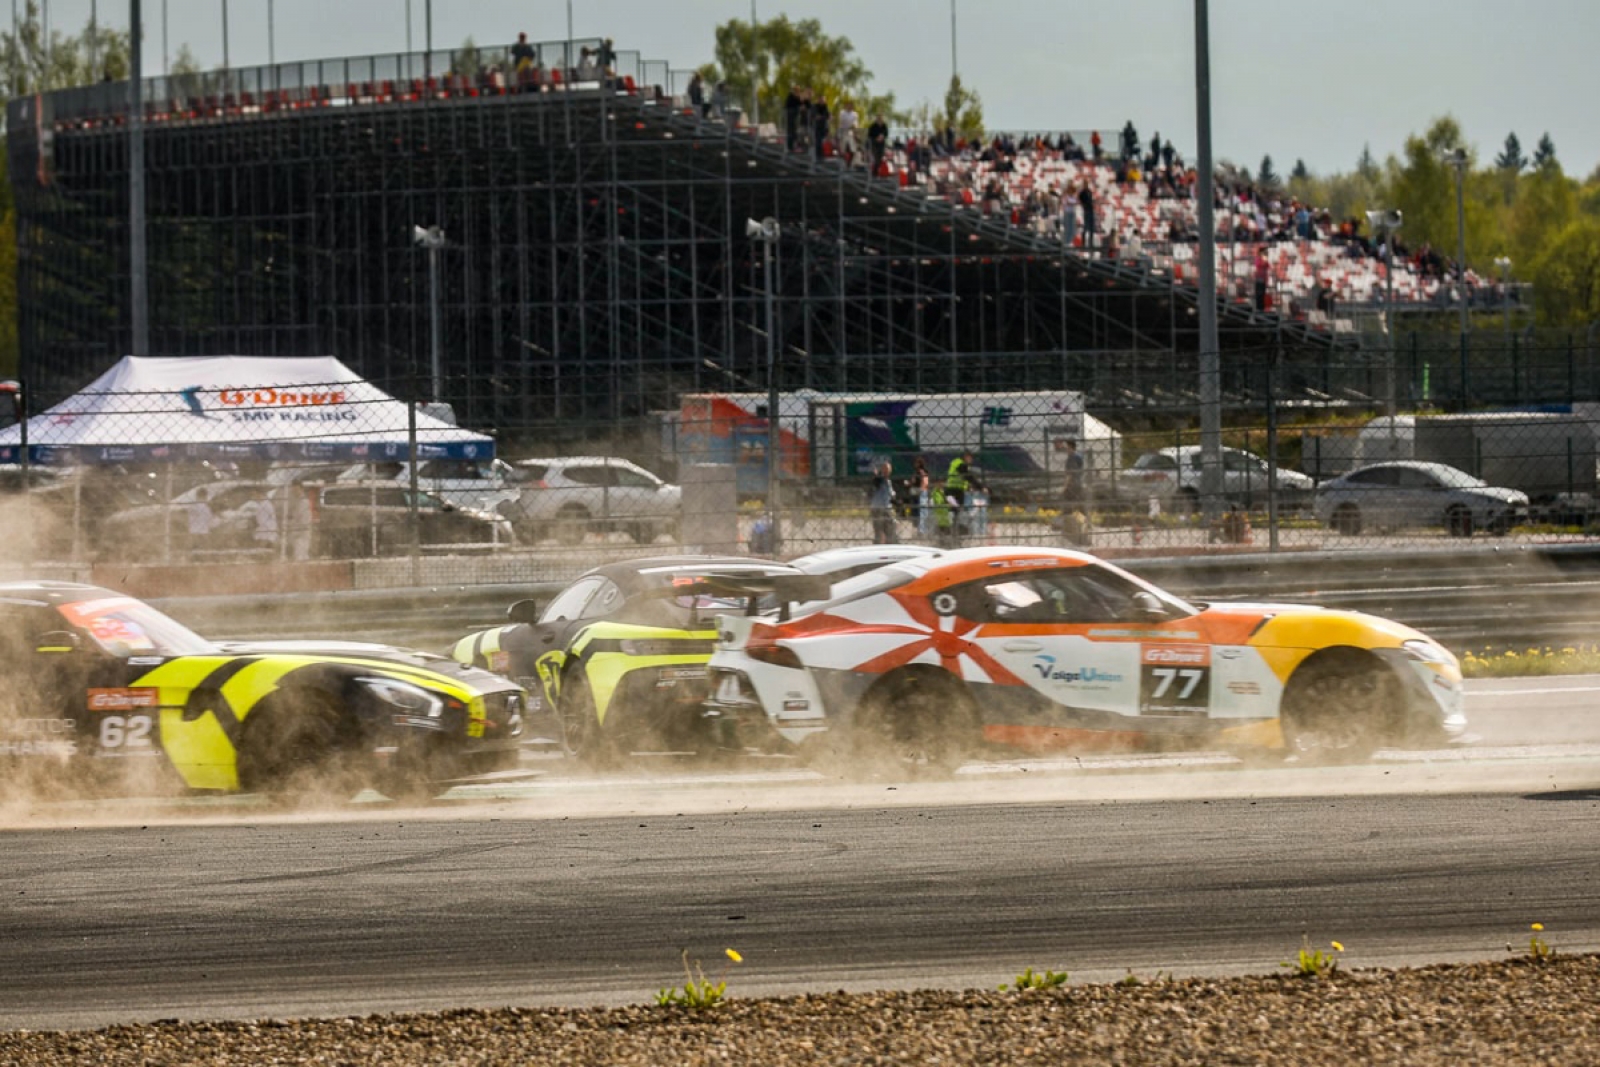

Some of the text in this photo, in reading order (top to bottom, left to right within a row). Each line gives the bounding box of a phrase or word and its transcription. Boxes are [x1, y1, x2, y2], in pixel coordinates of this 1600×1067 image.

[232, 410, 357, 422] SMP RACING
[1151, 668, 1205, 699] 77
[99, 715, 153, 748] 62
